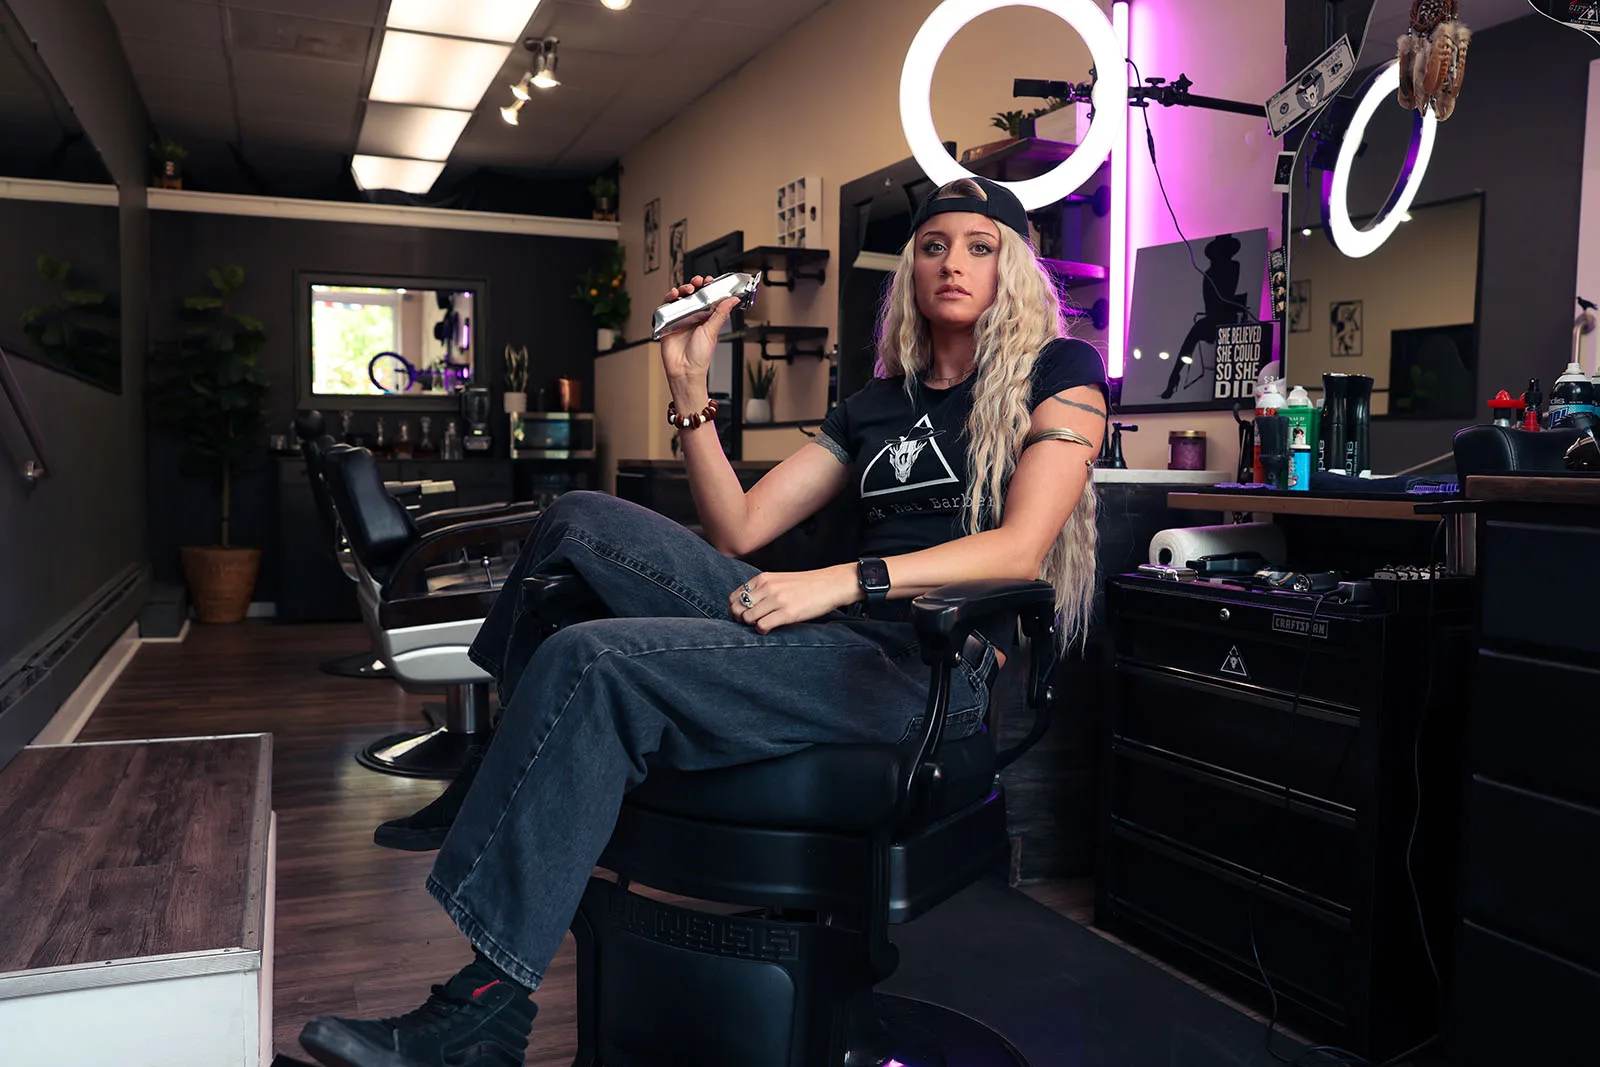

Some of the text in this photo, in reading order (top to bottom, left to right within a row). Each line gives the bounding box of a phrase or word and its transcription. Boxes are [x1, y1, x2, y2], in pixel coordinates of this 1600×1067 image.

[1218, 325, 1262, 345] SHE BELIEVED
[1216, 343, 1261, 363] SHE COULD
[1215, 362, 1260, 380] SO SHE
[1214, 380, 1258, 398] DID
